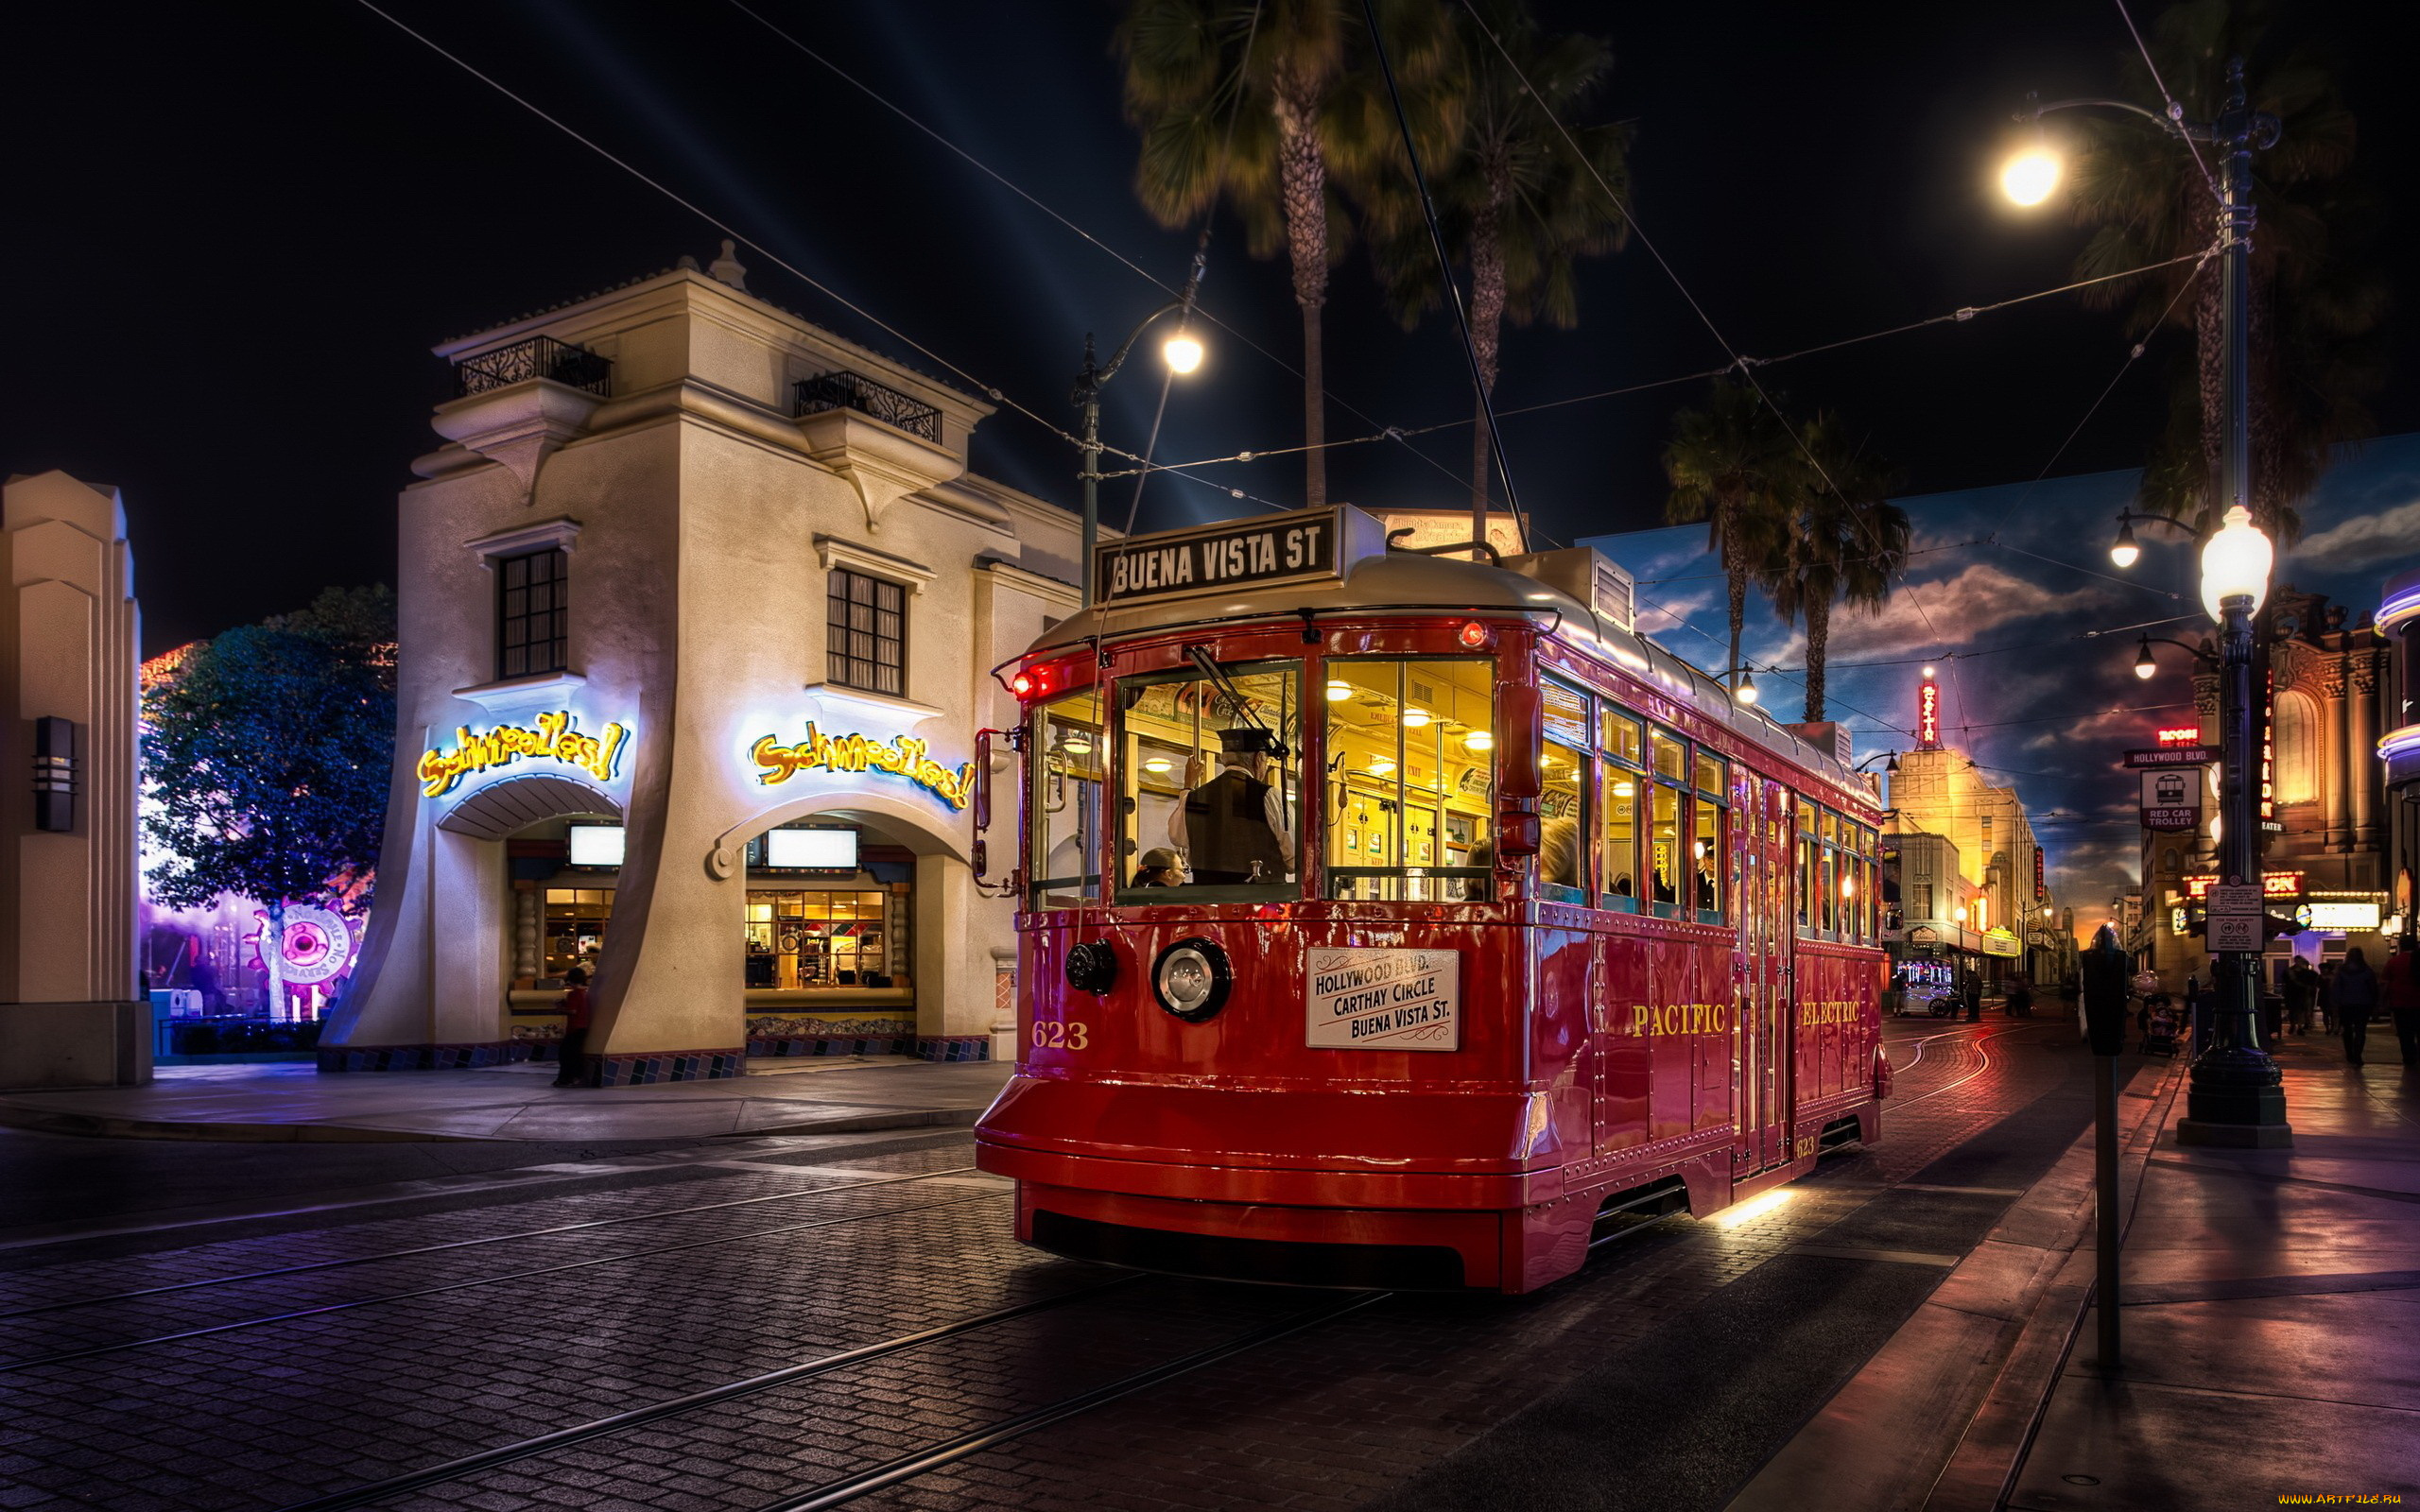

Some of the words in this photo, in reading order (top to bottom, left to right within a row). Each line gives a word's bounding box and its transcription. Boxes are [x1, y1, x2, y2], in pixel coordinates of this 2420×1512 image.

[1113, 545, 1193, 593] BUENA
[1203, 533, 1276, 580] VISTA
[1287, 525, 1321, 569] ST
[2134, 752, 2182, 763] HOLLYWOOD
[2186, 751, 2208, 761] BLVD.
[2149, 817, 2192, 826] TROLLEY
[2172, 809, 2191, 817] CAR
[1316, 962, 1392, 995] HOLLYWOOD
[1395, 955, 1429, 976] BLVD.
[1334, 988, 1387, 1016] CARTHAY
[1392, 977, 1435, 1003] CIRCLE
[1031, 1021, 1089, 1050] 623
[1352, 1014, 1391, 1039] BUENA
[1394, 1005, 1428, 1028] VISTA
[1433, 1000, 1450, 1020] ST.
[1633, 1004, 1725, 1038] PACIFIC
[1803, 1000, 1859, 1026] ELECTRIC
[1796, 1136, 1815, 1160] 623
